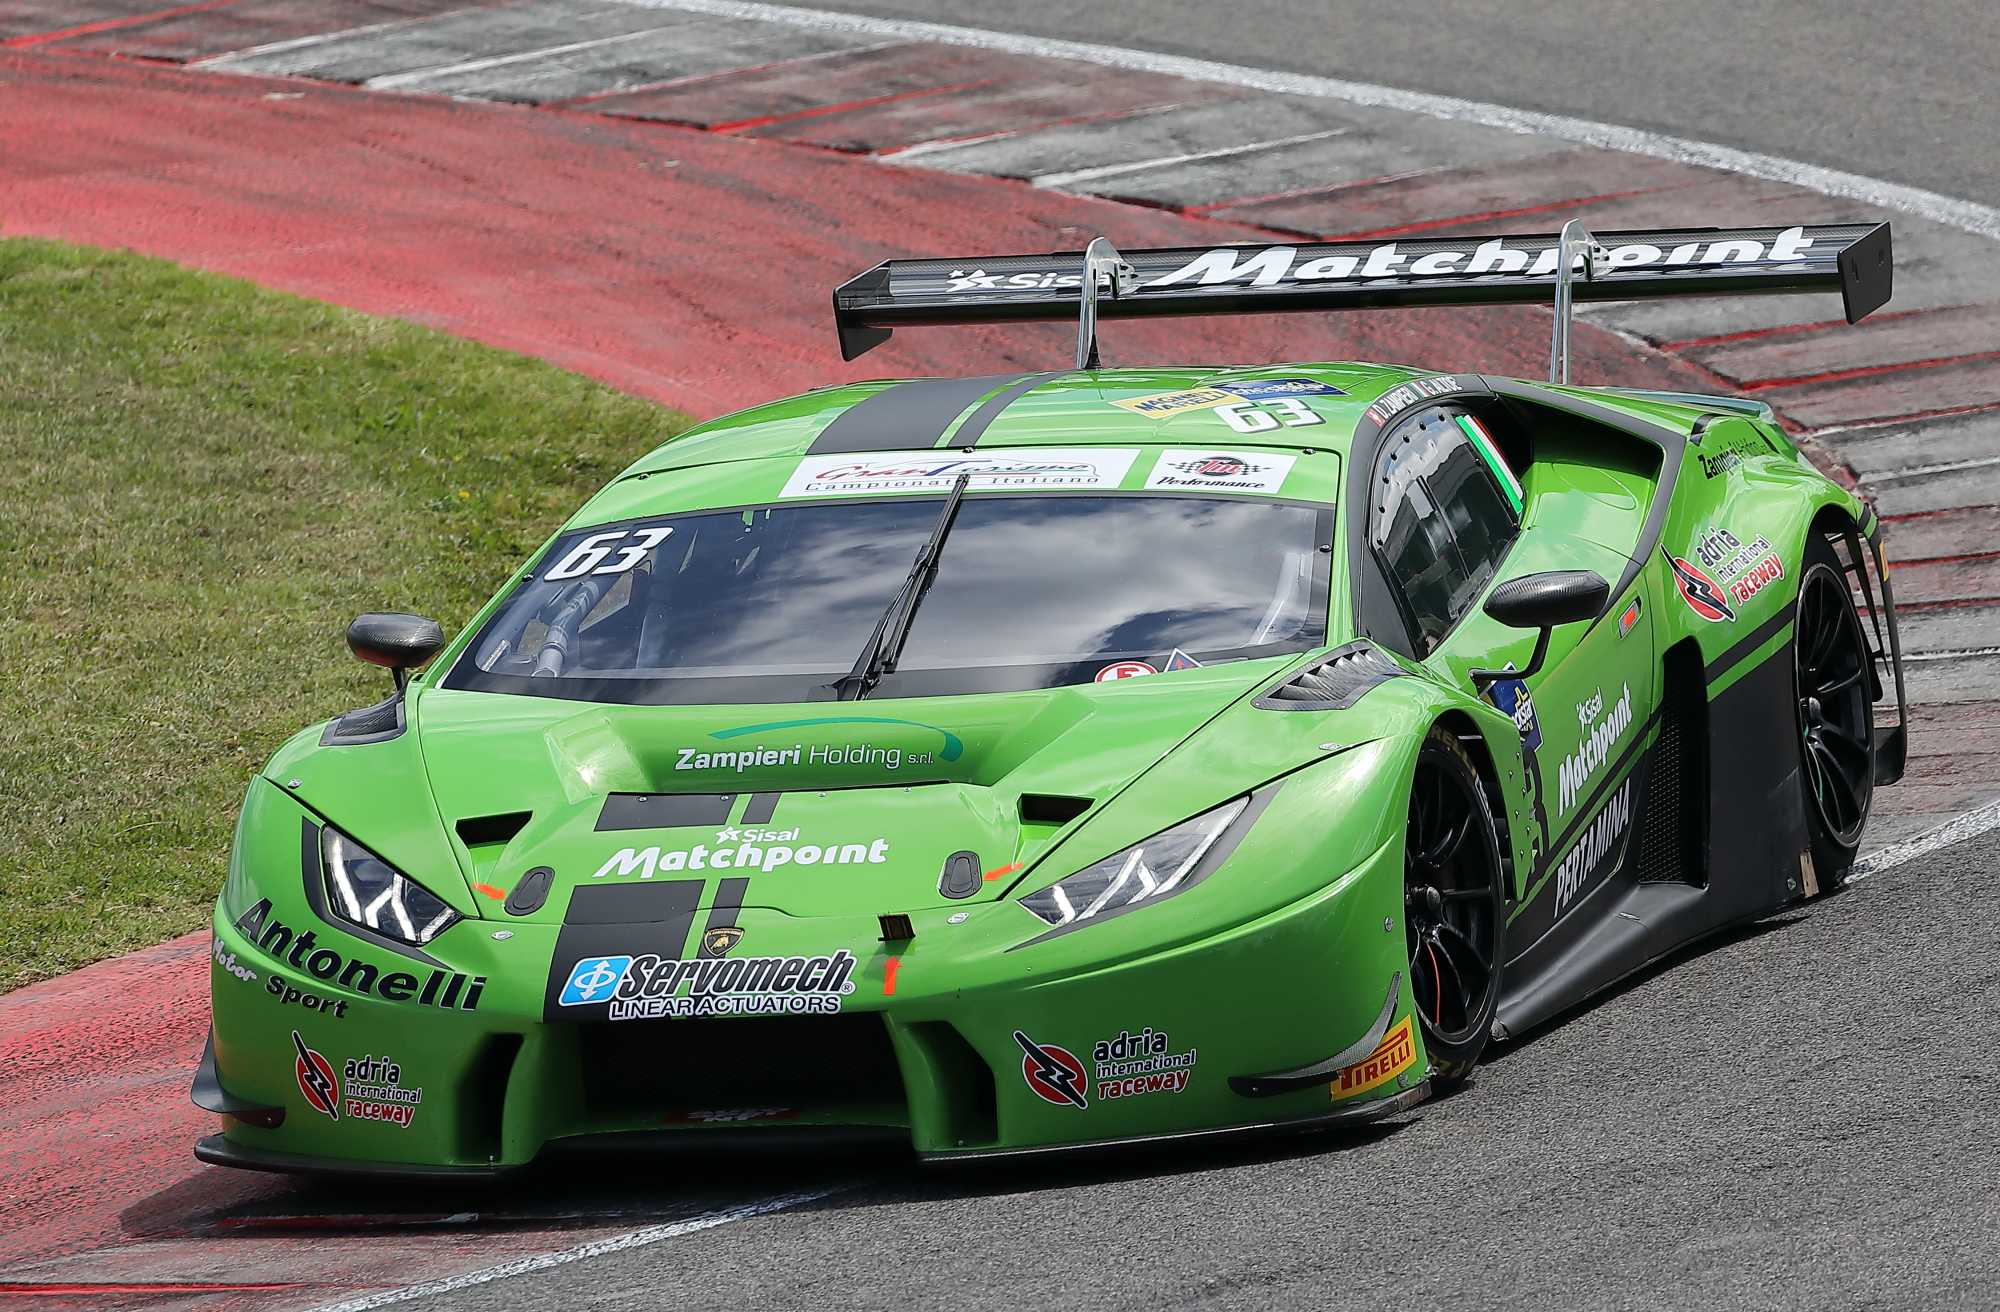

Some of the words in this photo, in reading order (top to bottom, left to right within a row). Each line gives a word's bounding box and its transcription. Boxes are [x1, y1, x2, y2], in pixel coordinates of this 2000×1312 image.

[1003, 272, 1110, 289] Sis
[1212, 399, 1326, 434] 63
[805, 479, 952, 491] Campionat
[991, 476, 1099, 485] Italiano
[1156, 476, 1266, 488] Performance
[543, 527, 675, 582] 63
[1696, 527, 1741, 568] adria
[1712, 534, 1772, 584] international
[1729, 552, 1785, 606] raceway
[1584, 686, 1604, 725] Sisal
[675, 744, 801, 773] Zampieri
[808, 743, 902, 770] Holding
[908, 750, 934, 765] s.r.l.
[1428, 724, 1477, 777] RELLI
[1558, 680, 1633, 818] Matchpoint
[741, 827, 800, 843] Sisal
[1553, 777, 1631, 919] PERTAMINA
[591, 838, 890, 879] Matchpoint
[234, 897, 488, 1011] Antonelli
[212, 937, 258, 982] Motor
[264, 974, 349, 1019] Sport
[609, 997, 694, 1020] LINEAR
[696, 995, 842, 1016] ACTUATORS
[1092, 1027, 1169, 1061] adria
[1341, 1027, 1411, 1090] PIRELLI
[344, 1055, 401, 1084] adria
[1095, 1048, 1197, 1077] international
[344, 1082, 422, 1104] international
[1098, 1069, 1191, 1101] raceway
[345, 1099, 415, 1129] raceway
